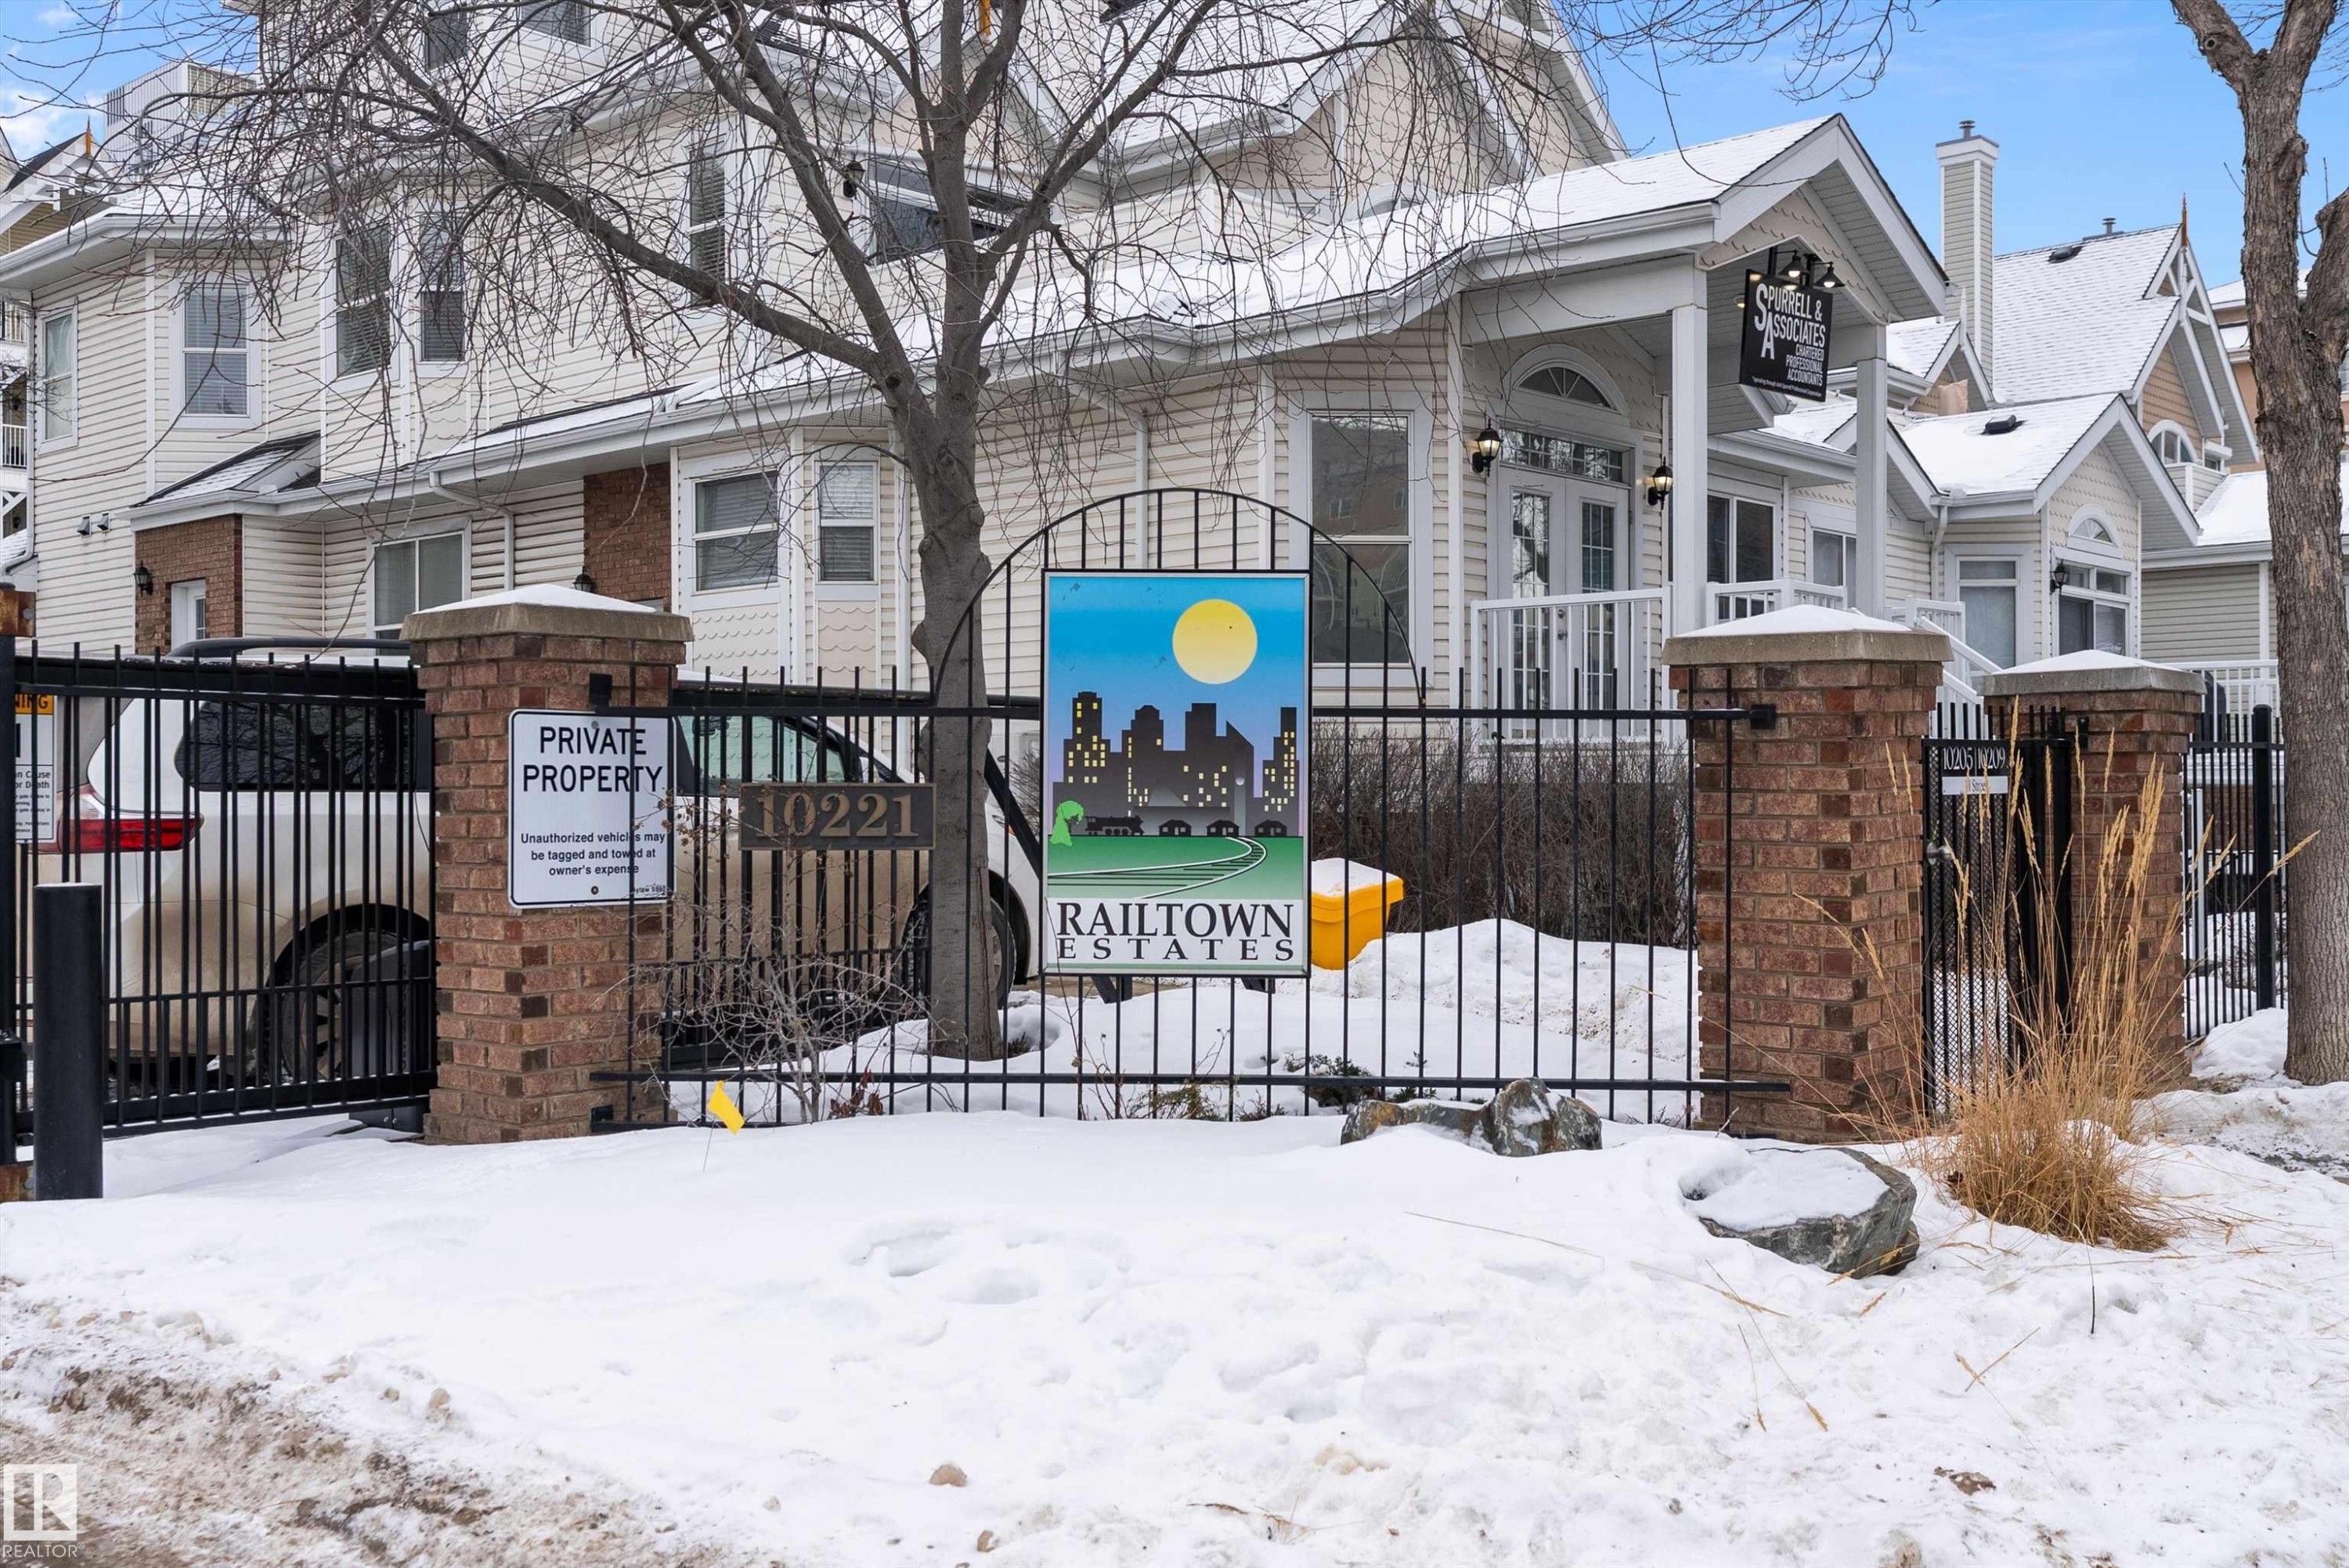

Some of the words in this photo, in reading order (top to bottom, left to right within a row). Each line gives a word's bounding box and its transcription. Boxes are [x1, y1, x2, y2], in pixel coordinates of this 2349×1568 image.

[1754, 283, 1812, 331] SPURRELL
[1815, 300, 1823, 322] &
[1761, 312, 1826, 360] ASSOCIATES
[1786, 354, 1824, 374] PROFESSIONAL
[1795, 344, 1824, 362] CHARTERED
[1787, 368, 1824, 387] ACCOUNTANTS
[539, 726, 647, 755] PRIVATE
[1943, 746, 1973, 770] 10205
[1978, 746, 2005, 769] 10209
[523, 764, 663, 792] PROPERTY
[756, 792, 919, 838] 10221
[521, 832, 594, 844] Unauthorized
[597, 832, 640, 842] vehicls
[644, 833, 666, 844] may
[531, 850, 544, 860] be
[548, 849, 585, 862] tagged
[588, 849, 608, 860] and
[646, 849, 656, 858] at
[549, 865, 591, 876] owner's
[1057, 902, 1294, 938] RAILTOWN
[1059, 938, 1294, 961] ESTATES
